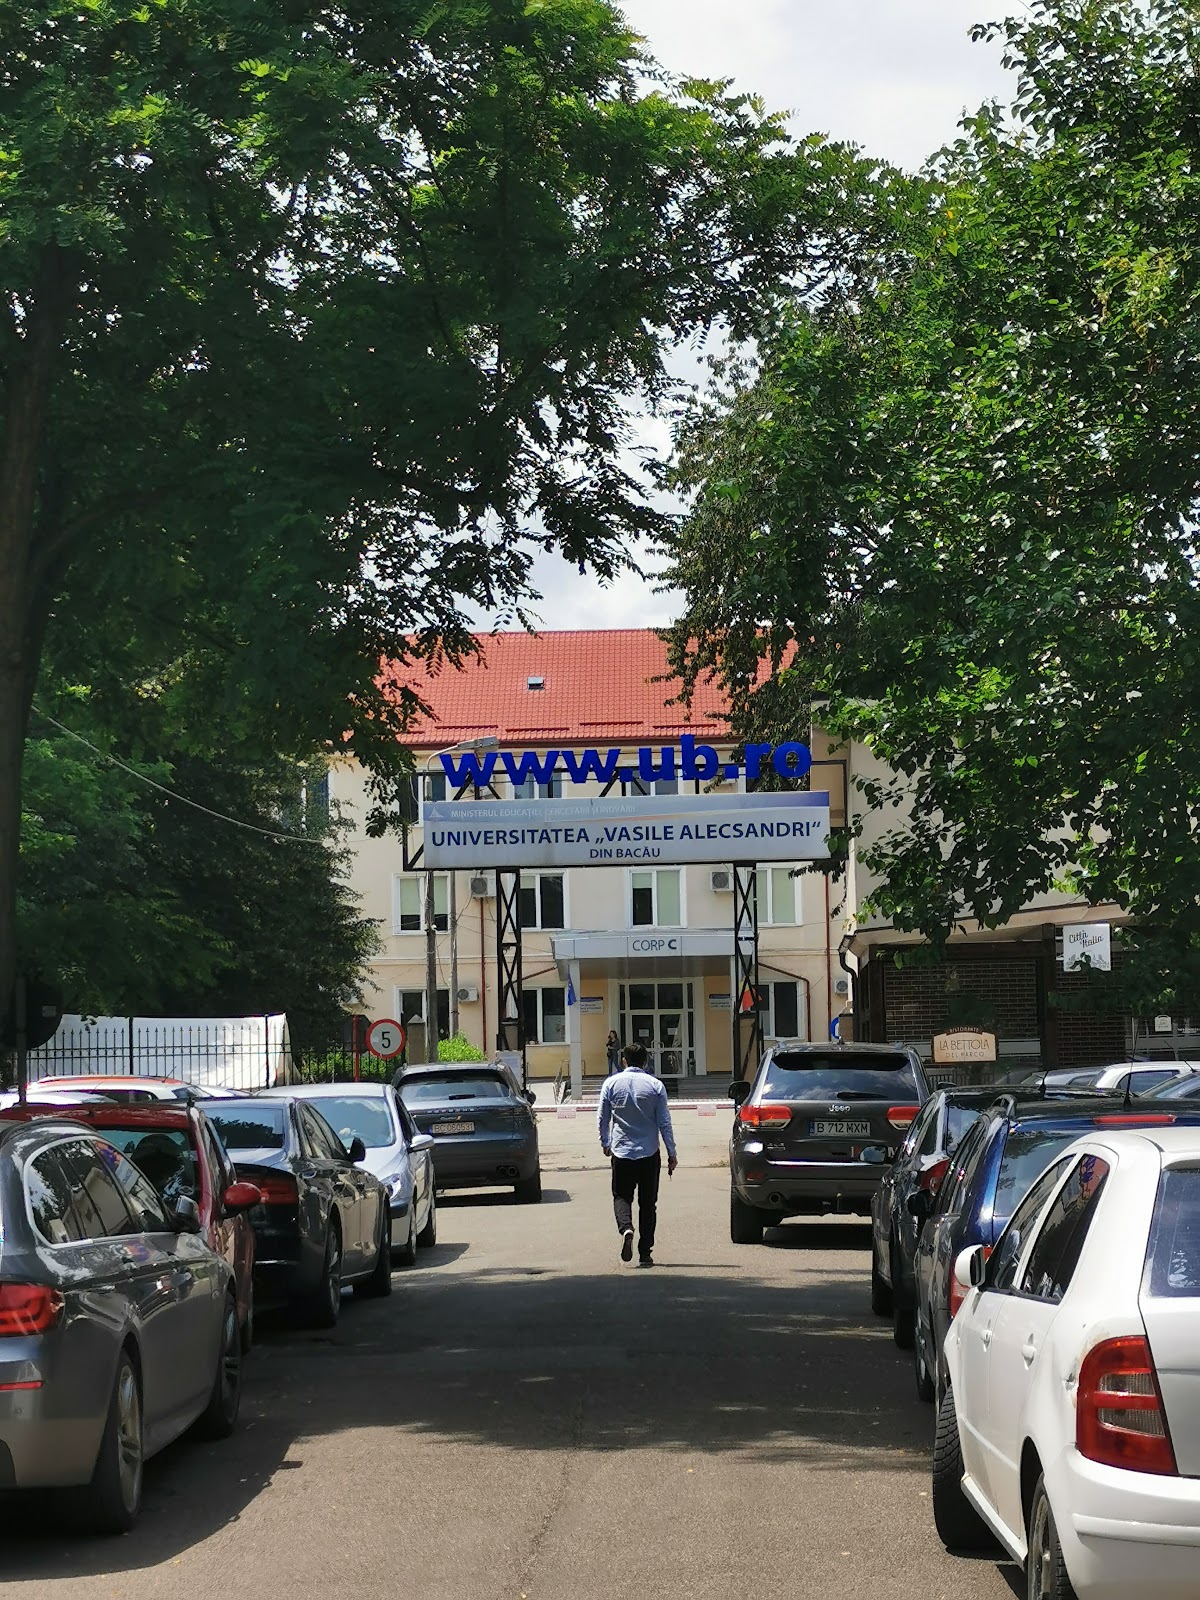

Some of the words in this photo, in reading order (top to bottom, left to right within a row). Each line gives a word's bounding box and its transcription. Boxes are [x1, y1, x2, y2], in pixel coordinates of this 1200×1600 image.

[439, 733, 813, 788] www.ub.ro
[451, 809, 499, 820] MINISTERUL
[431, 828, 590, 847] UNIVERSITATEA
[589, 849, 613, 859] DIN
[616, 846, 661, 858] BACĂU
[632, 939, 665, 951] CORP
[667, 939, 677, 950] C
[381, 1031, 391, 1049] 5
[939, 1040, 949, 1051] LA
[950, 1039, 990, 1051] BETTOLA
[816, 1122, 825, 1133] B
[828, 1122, 844, 1133] 712
[846, 1122, 868, 1133] MXM
